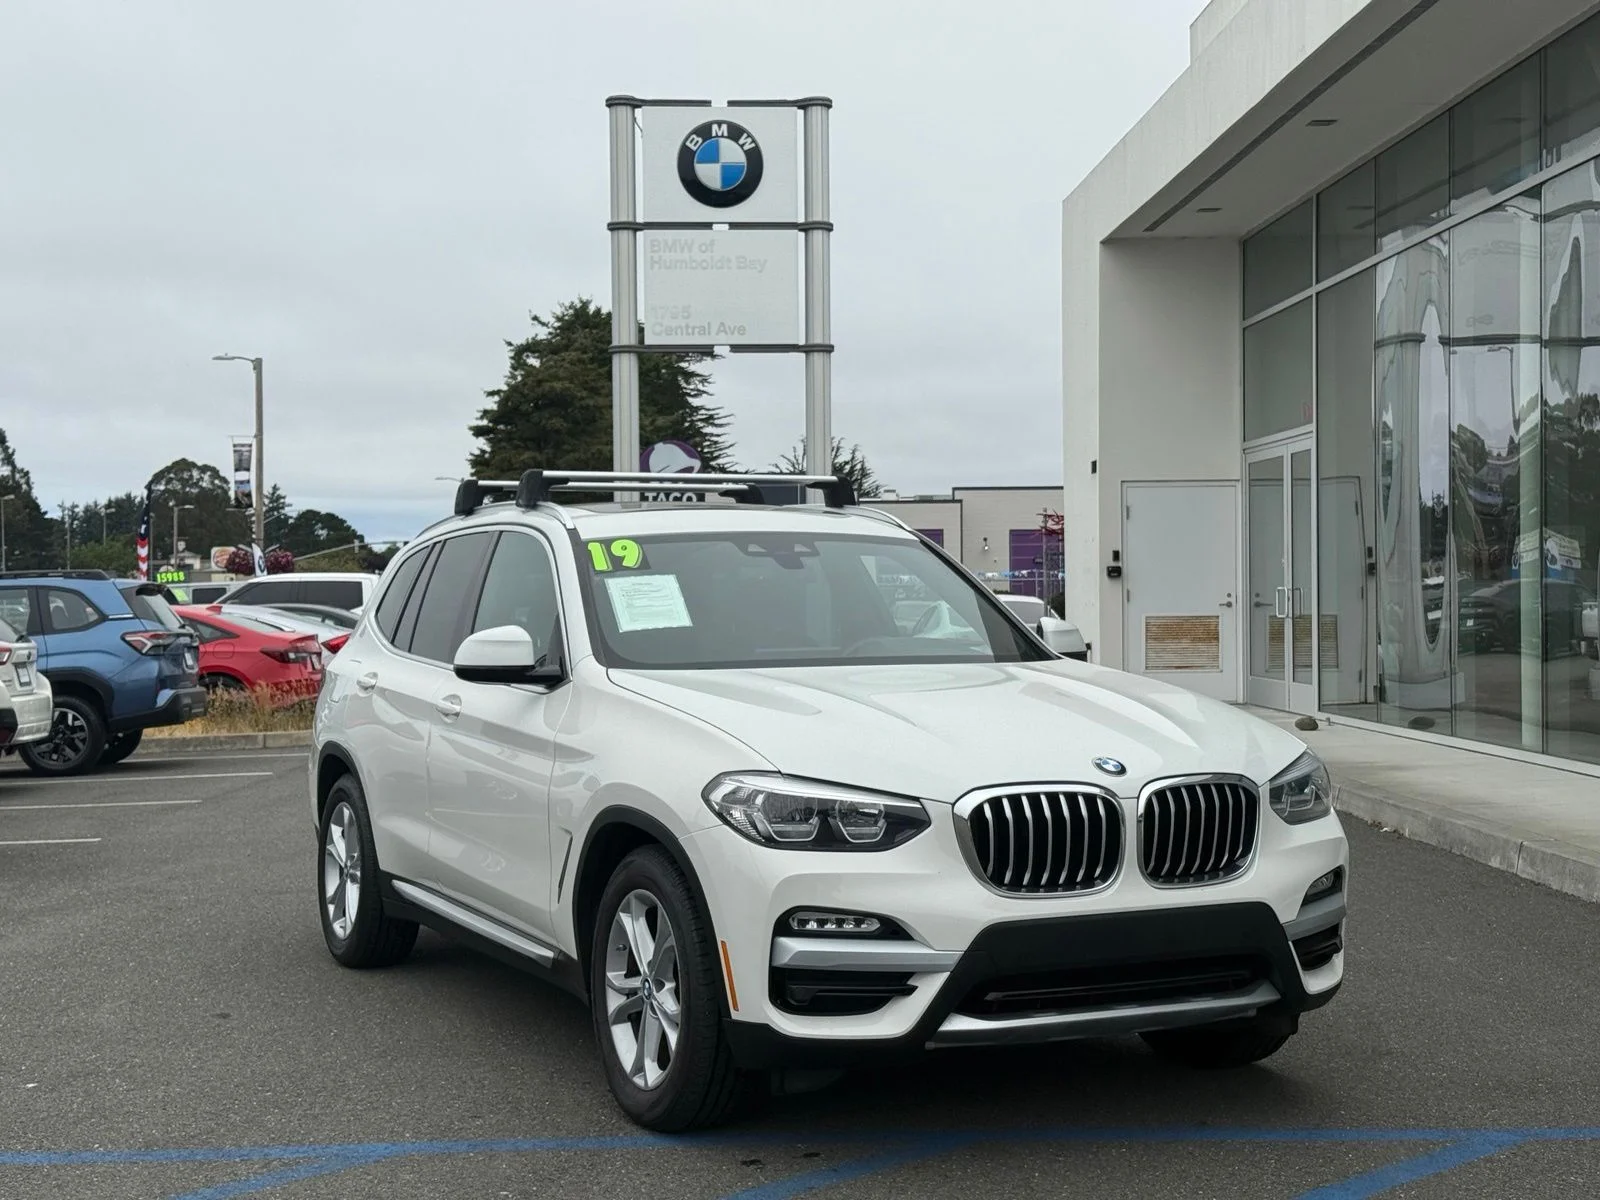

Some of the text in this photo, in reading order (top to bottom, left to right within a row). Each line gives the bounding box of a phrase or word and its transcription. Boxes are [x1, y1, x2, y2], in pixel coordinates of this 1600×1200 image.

[685, 123, 756, 152] BMW
[649, 239, 716, 254] BMW of
[649, 255, 768, 274] Humboldt Bay
[650, 321, 747, 337] Central Ave
[587, 539, 643, 571] 19
[156, 571, 185, 584] 15988
